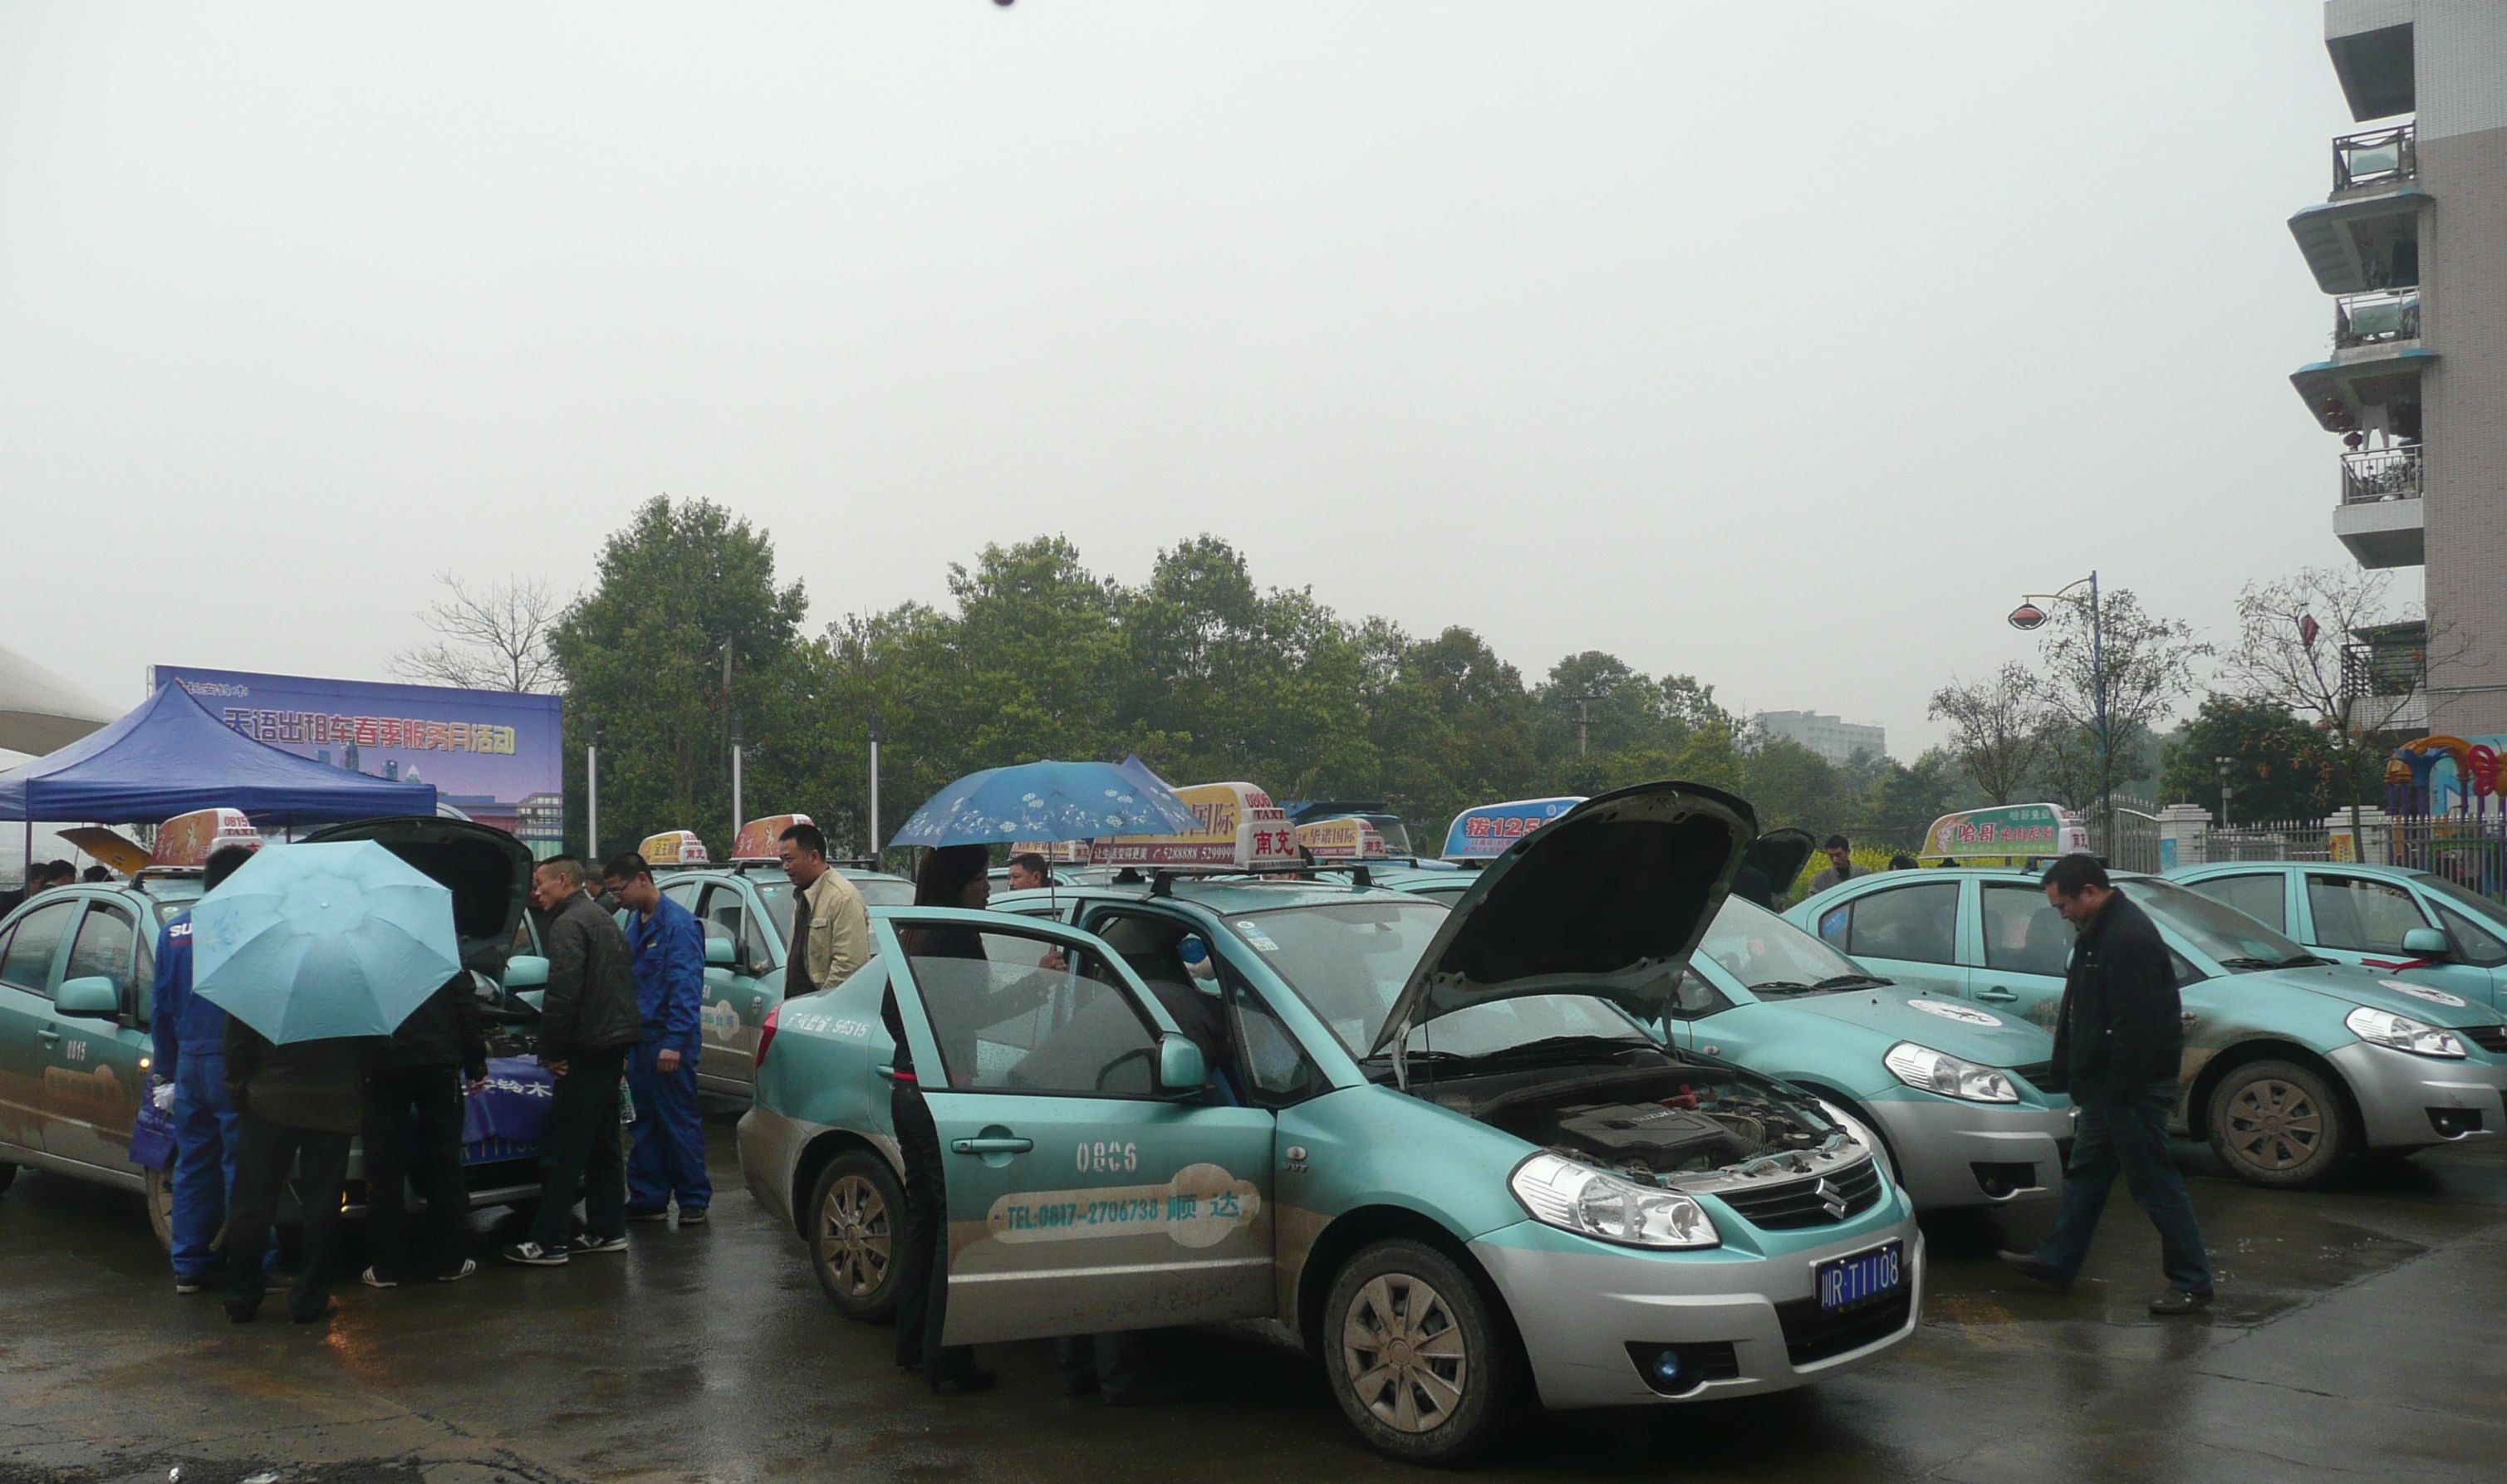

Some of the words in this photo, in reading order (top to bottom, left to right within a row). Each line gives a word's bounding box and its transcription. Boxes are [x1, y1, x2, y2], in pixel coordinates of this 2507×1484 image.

[223, 708, 517, 755] 天语出租车春季服务月活动
[1246, 793, 1270, 809] 0806
[223, 816, 248, 827] 0815
[1255, 810, 1284, 820] TAXI
[1957, 823, 1996, 844] 哈哥
[1253, 830, 1294, 856] 南充
[1163, 846, 1198, 860] 5288888
[1007, 1198, 1159, 1231] TEL:0817-2706738
[1166, 1189, 1241, 1222] 顺达
